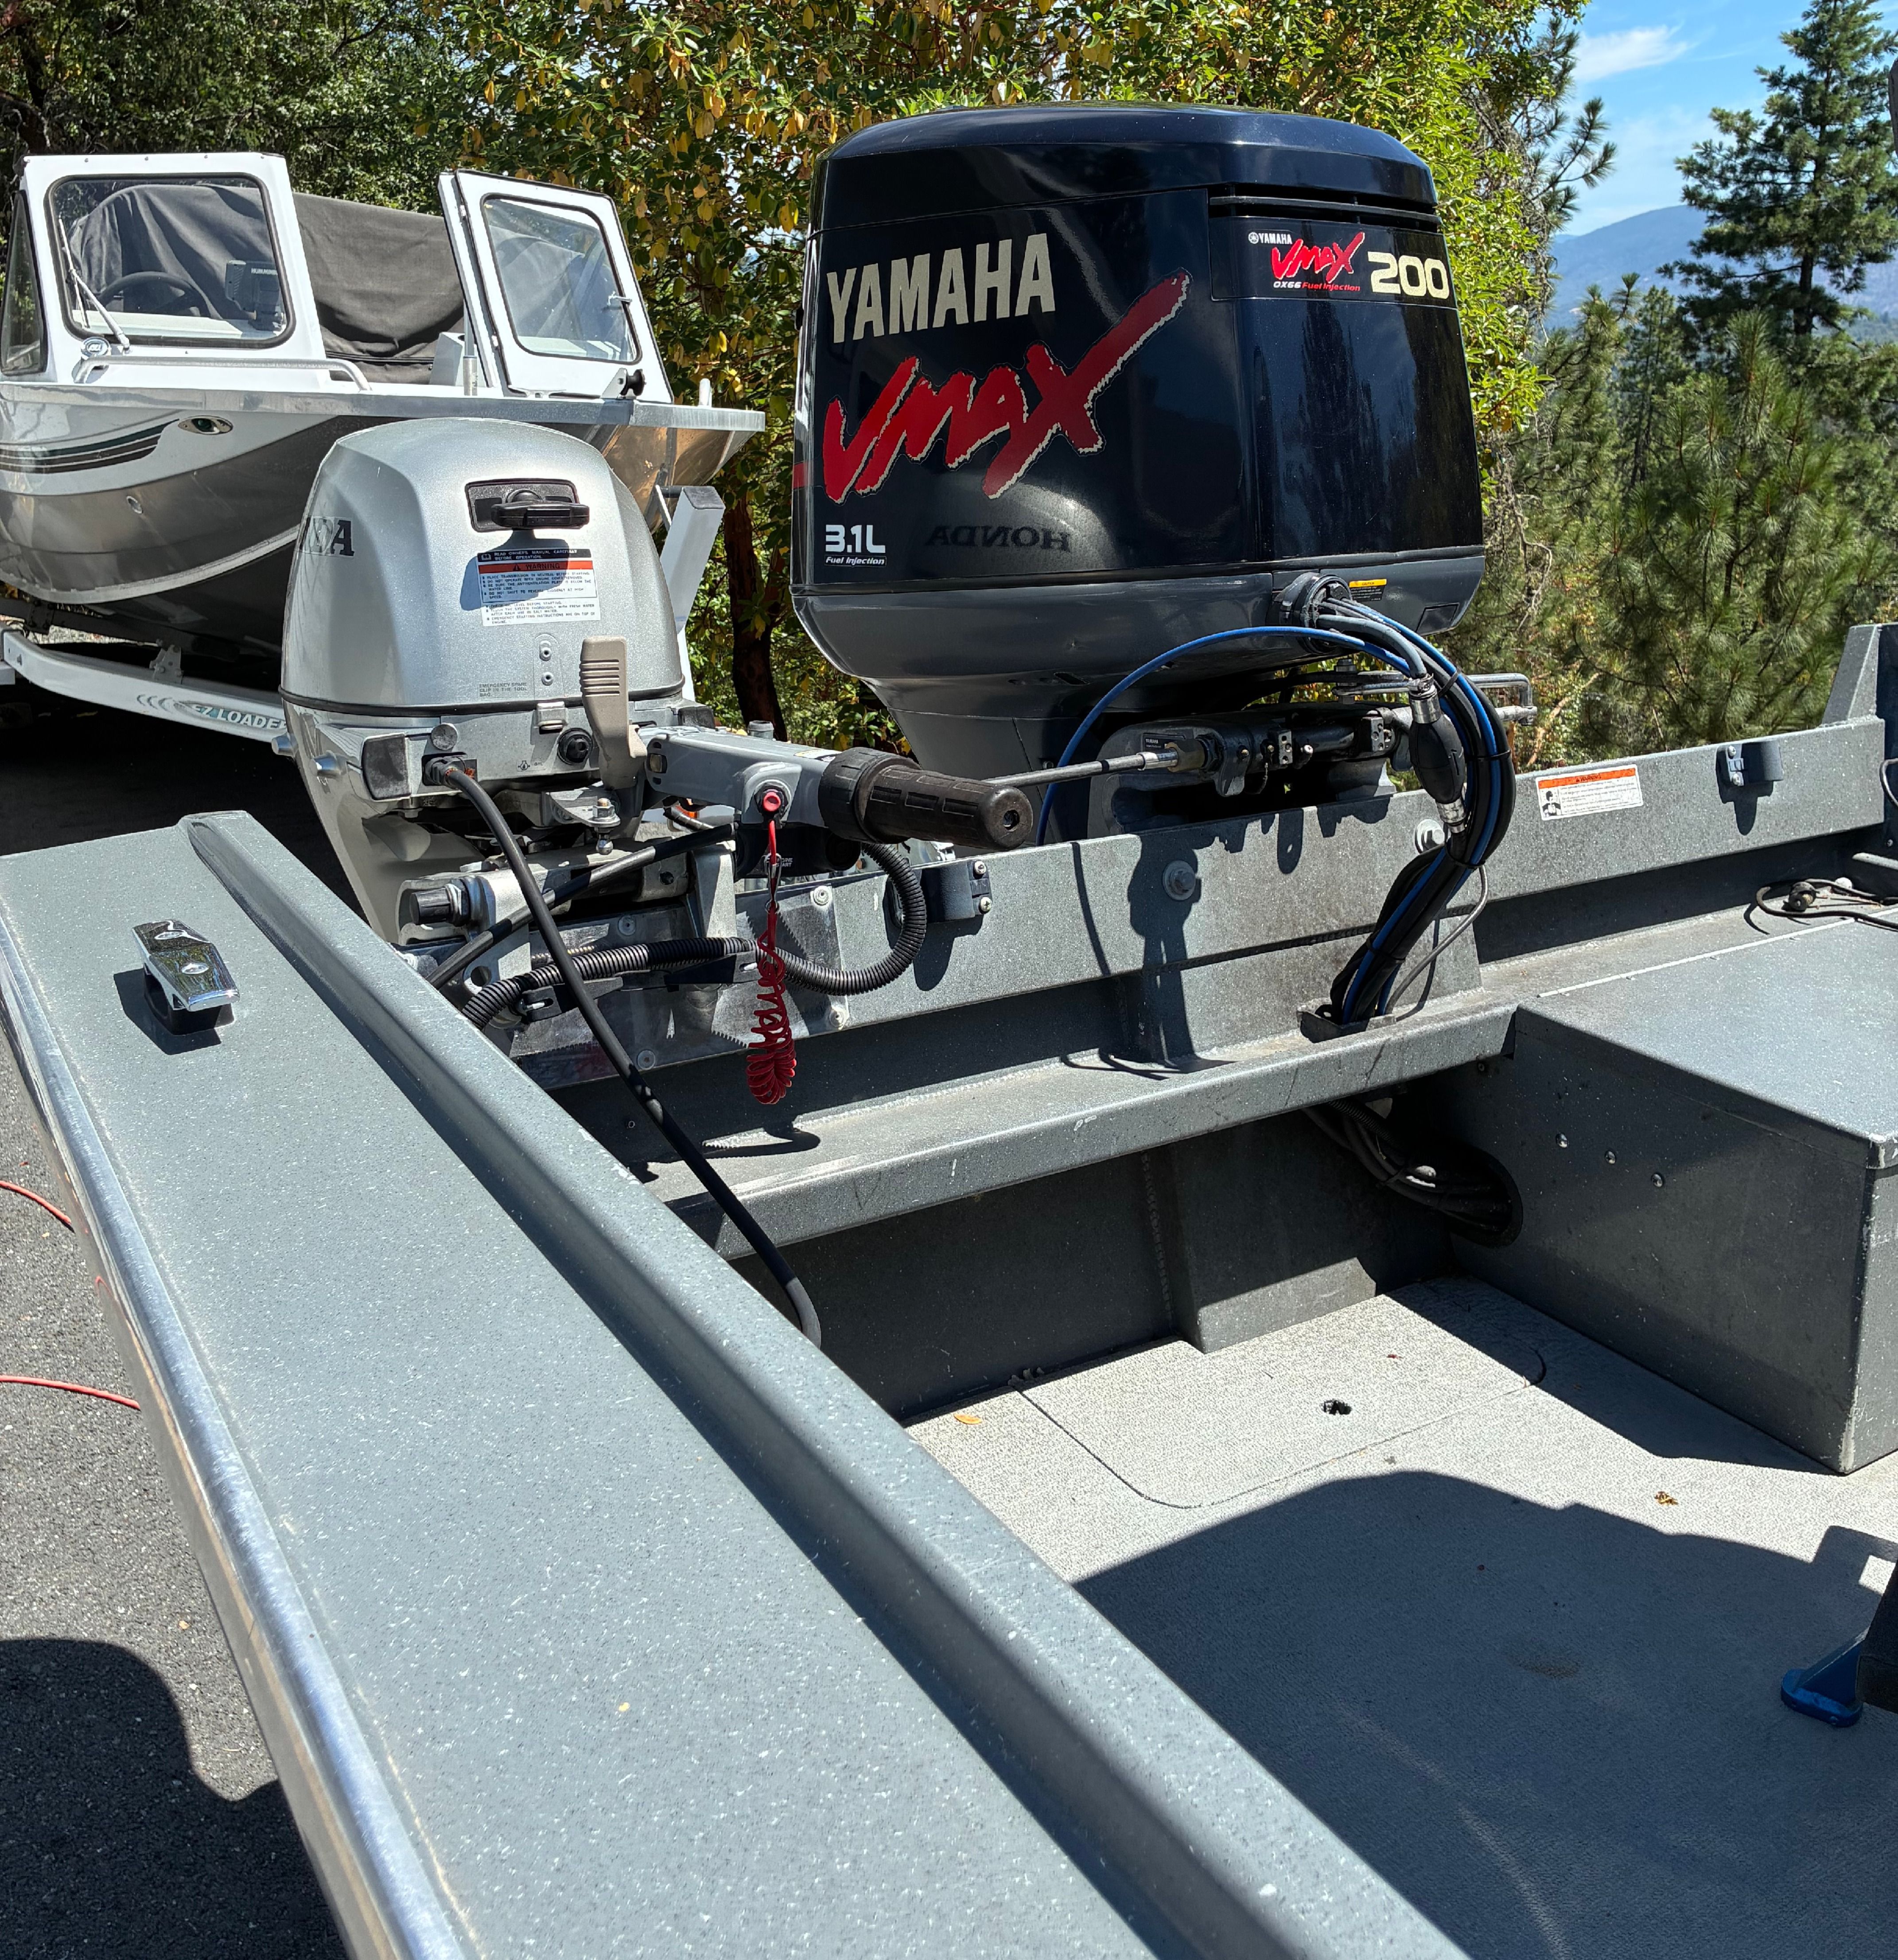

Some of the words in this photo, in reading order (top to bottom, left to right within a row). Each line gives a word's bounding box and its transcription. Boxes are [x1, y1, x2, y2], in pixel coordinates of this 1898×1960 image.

[1258, 233, 1292, 244] YAMAHA
[1368, 251, 1450, 299] 200
[826, 233, 1055, 343] YAMAHA
[1323, 283, 1361, 291] Injection
[825, 524, 886, 553] 3.1L
[846, 557, 885, 565] Injection
[191, 704, 213, 717] EZ
[1580, 774, 1601, 783] WARNING
